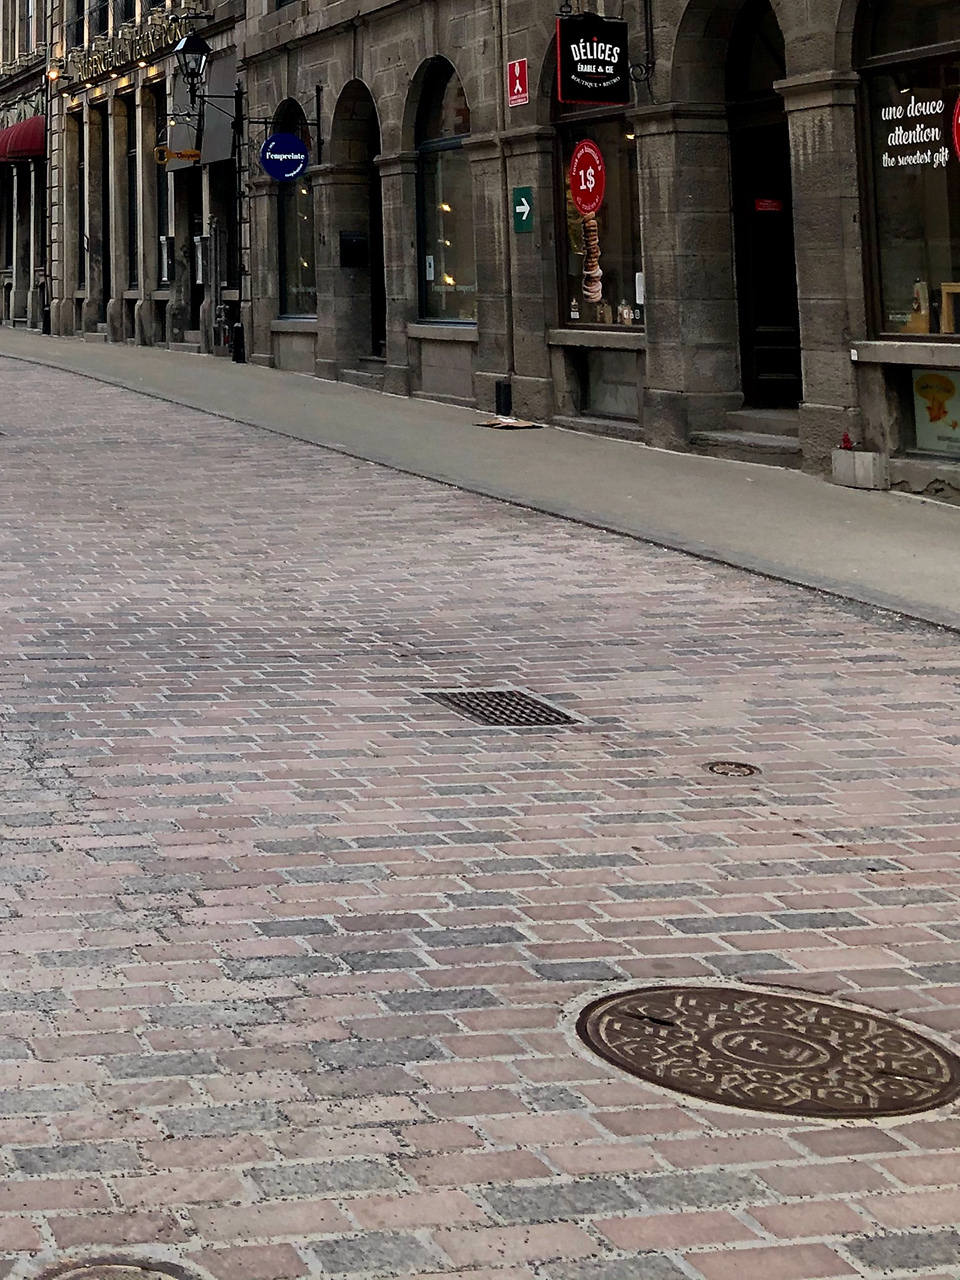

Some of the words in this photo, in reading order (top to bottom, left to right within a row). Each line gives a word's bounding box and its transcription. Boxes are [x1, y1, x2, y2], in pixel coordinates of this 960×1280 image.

[570, 38, 620, 63] DÉLICES
[597, 65, 604, 73] &
[881, 105, 904, 121] une
[906, 95, 945, 118] douce
[887, 123, 941, 146] attention
[882, 151, 896, 167] the
[897, 149, 932, 166] sweetest
[933, 146, 950, 169] gift
[579, 166, 596, 193] 1$
